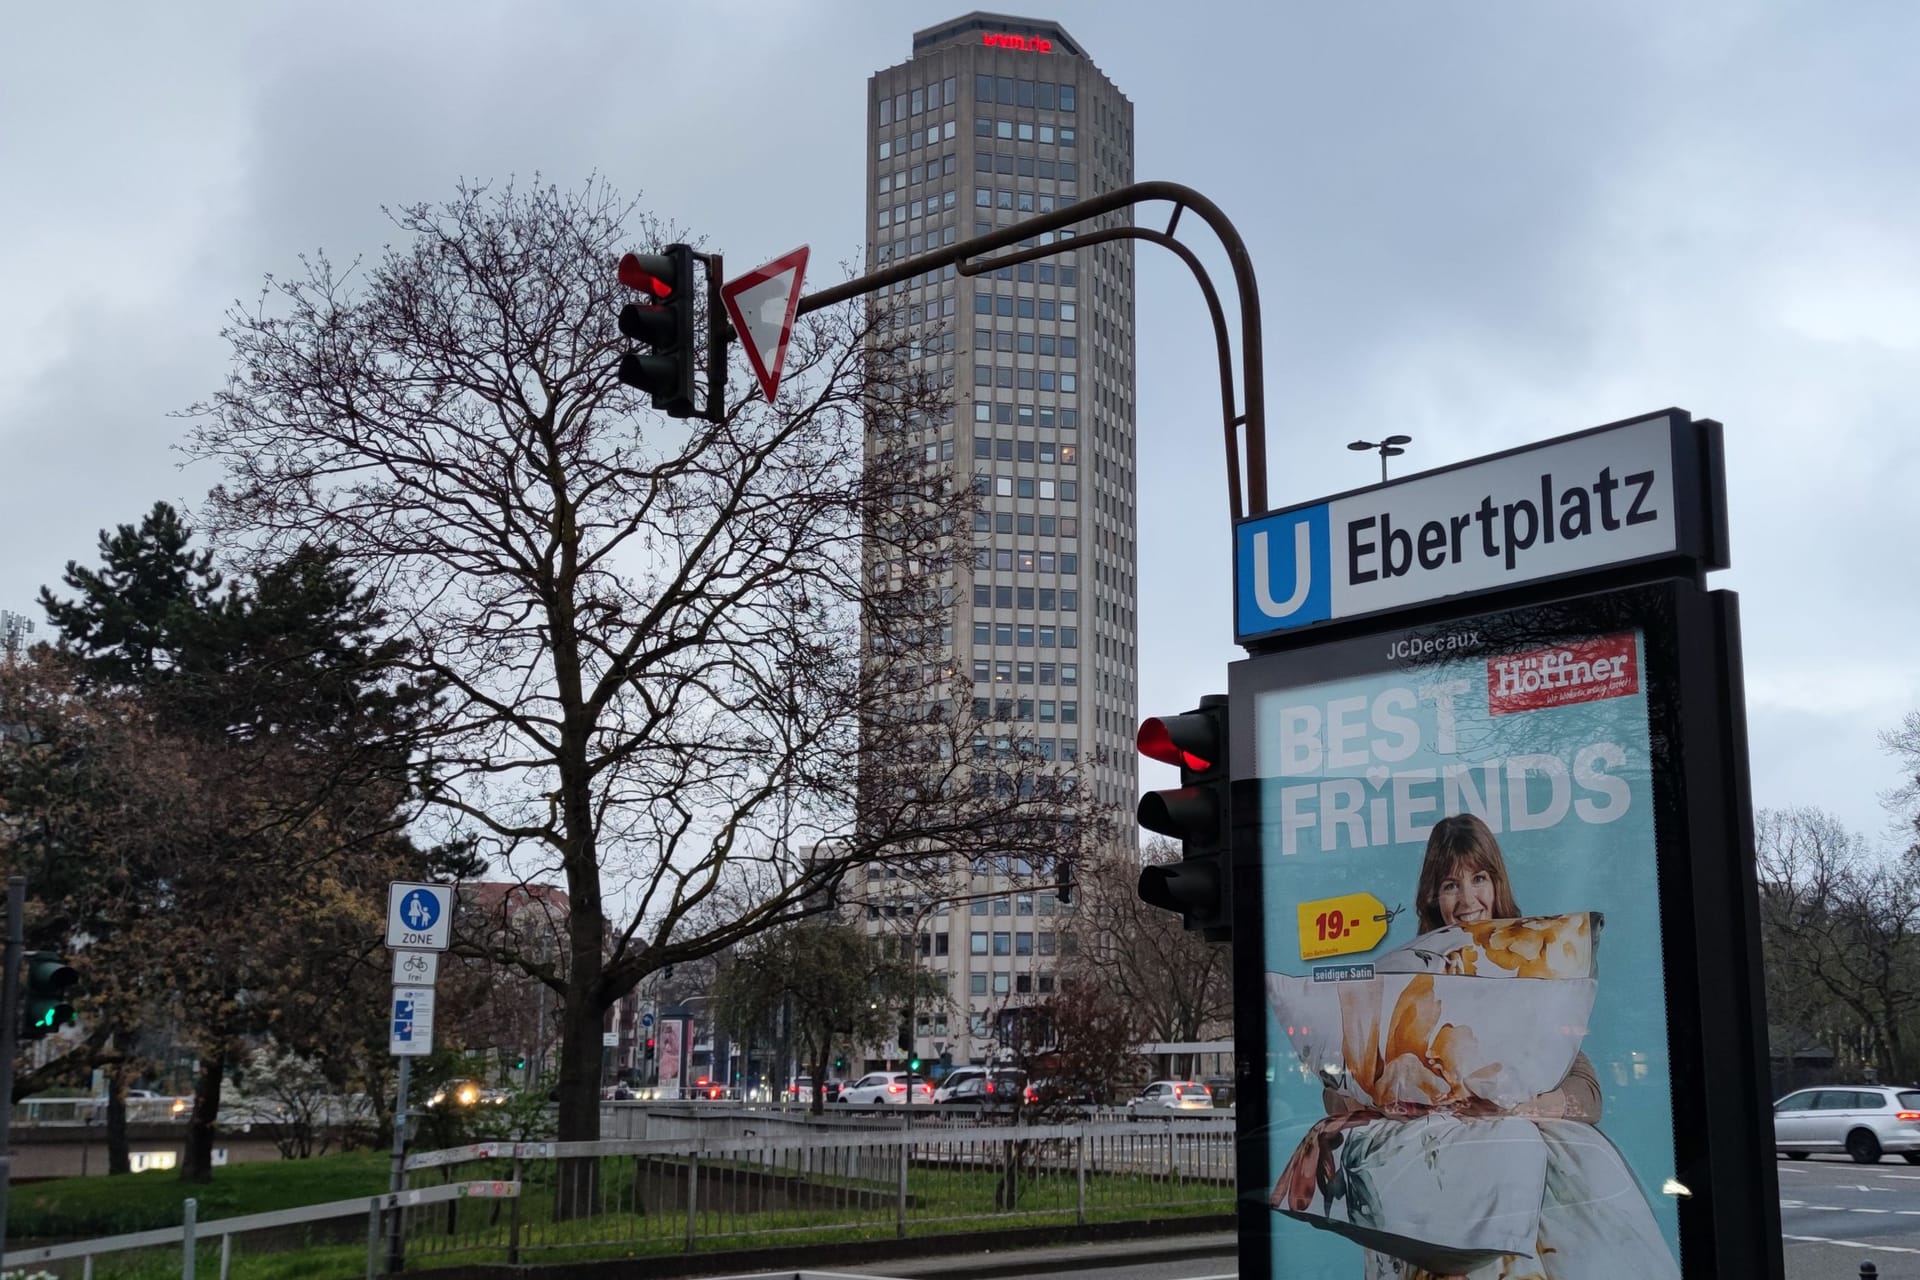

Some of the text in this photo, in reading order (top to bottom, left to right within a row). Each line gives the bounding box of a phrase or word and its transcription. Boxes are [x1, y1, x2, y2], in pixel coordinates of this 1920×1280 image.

[1253, 466, 1658, 618] U Ebertplatz
[1386, 631, 1480, 661] JCDecaux
[1495, 651, 1629, 696] Höffner
[1280, 679, 1471, 776] BEST
[402, 933, 433, 945] ZONE
[408, 973, 422, 981] frei
[1315, 967, 1373, 982] seidiger Satin
